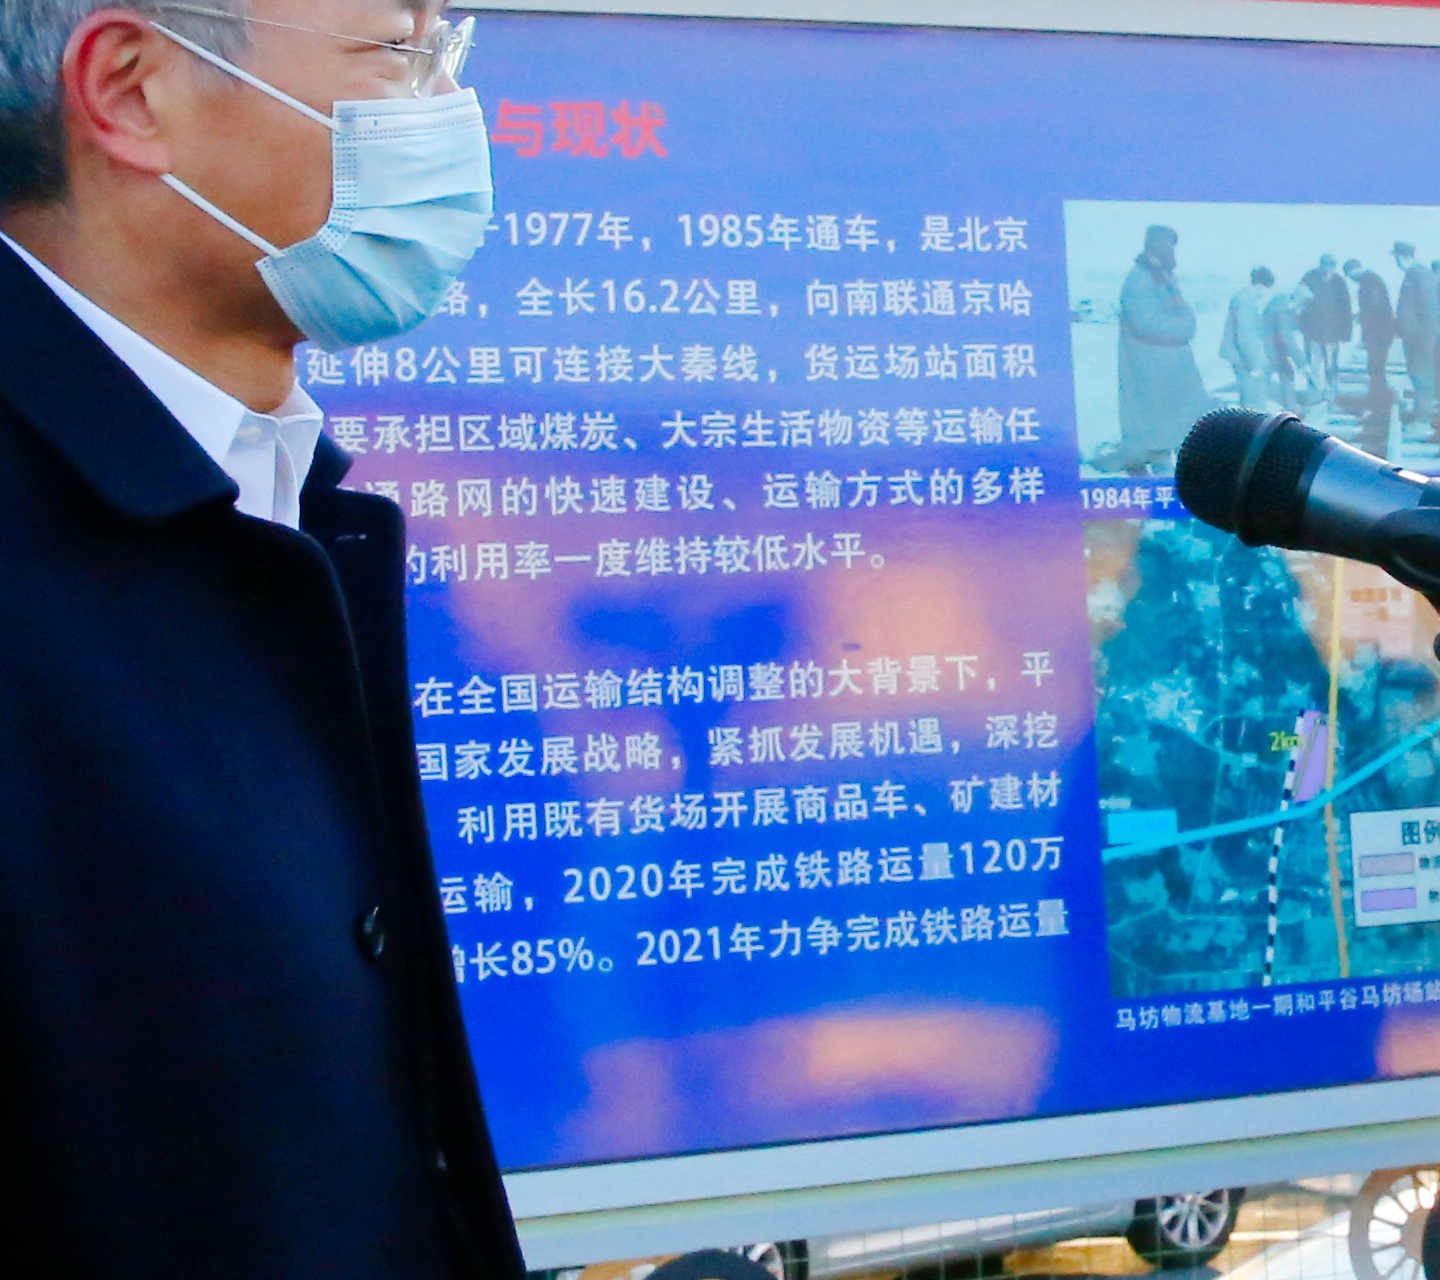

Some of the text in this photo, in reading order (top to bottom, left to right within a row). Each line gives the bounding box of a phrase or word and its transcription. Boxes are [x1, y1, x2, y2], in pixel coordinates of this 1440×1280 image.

[490, 99, 668, 158] 与现状
[485, 211, 1029, 253] 1977年，1985年通车，是北京
[293, 344, 1039, 388] 延伸8公里可连接大秦线，货运场站面积
[336, 469, 1046, 518] 路网的快速建设、运输方式的多样
[1080, 485, 1185, 510] 1984年平
[413, 650, 1055, 718] 在全国运输结构调整的大背景下，平
[457, 771, 1062, 845] 利用既有货场开展商品车、矿建材
